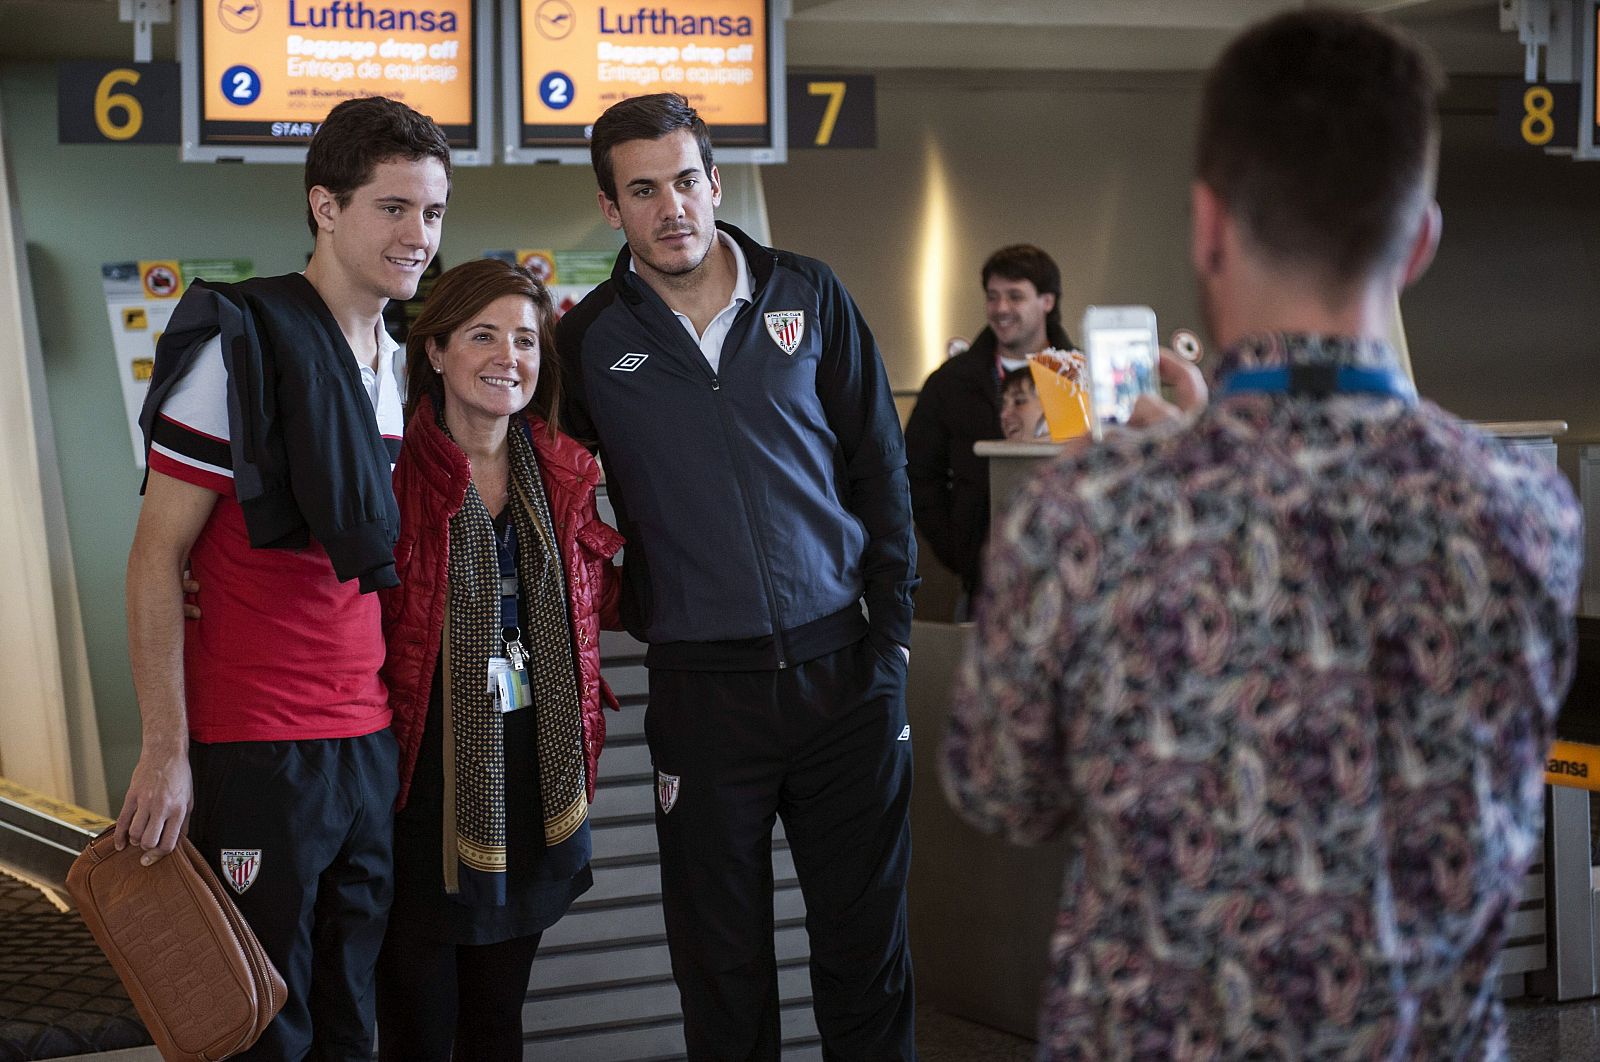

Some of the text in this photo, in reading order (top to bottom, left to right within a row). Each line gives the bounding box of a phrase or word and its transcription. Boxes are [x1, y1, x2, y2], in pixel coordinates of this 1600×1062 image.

[288, 0, 457, 32] Lufthansa
[599, 7, 752, 37] Lufthansa
[287, 35, 459, 61] Baggage drop off
[233, 71, 252, 98] 2
[287, 58, 458, 84] Entrega de equipaje
[598, 64, 659, 84] Entrega
[661, 65, 684, 82] de
[548, 77, 568, 103] 2
[94, 69, 143, 141] 6
[807, 82, 846, 145] 7
[1521, 86, 1554, 145] 8
[271, 122, 313, 137] STAR
